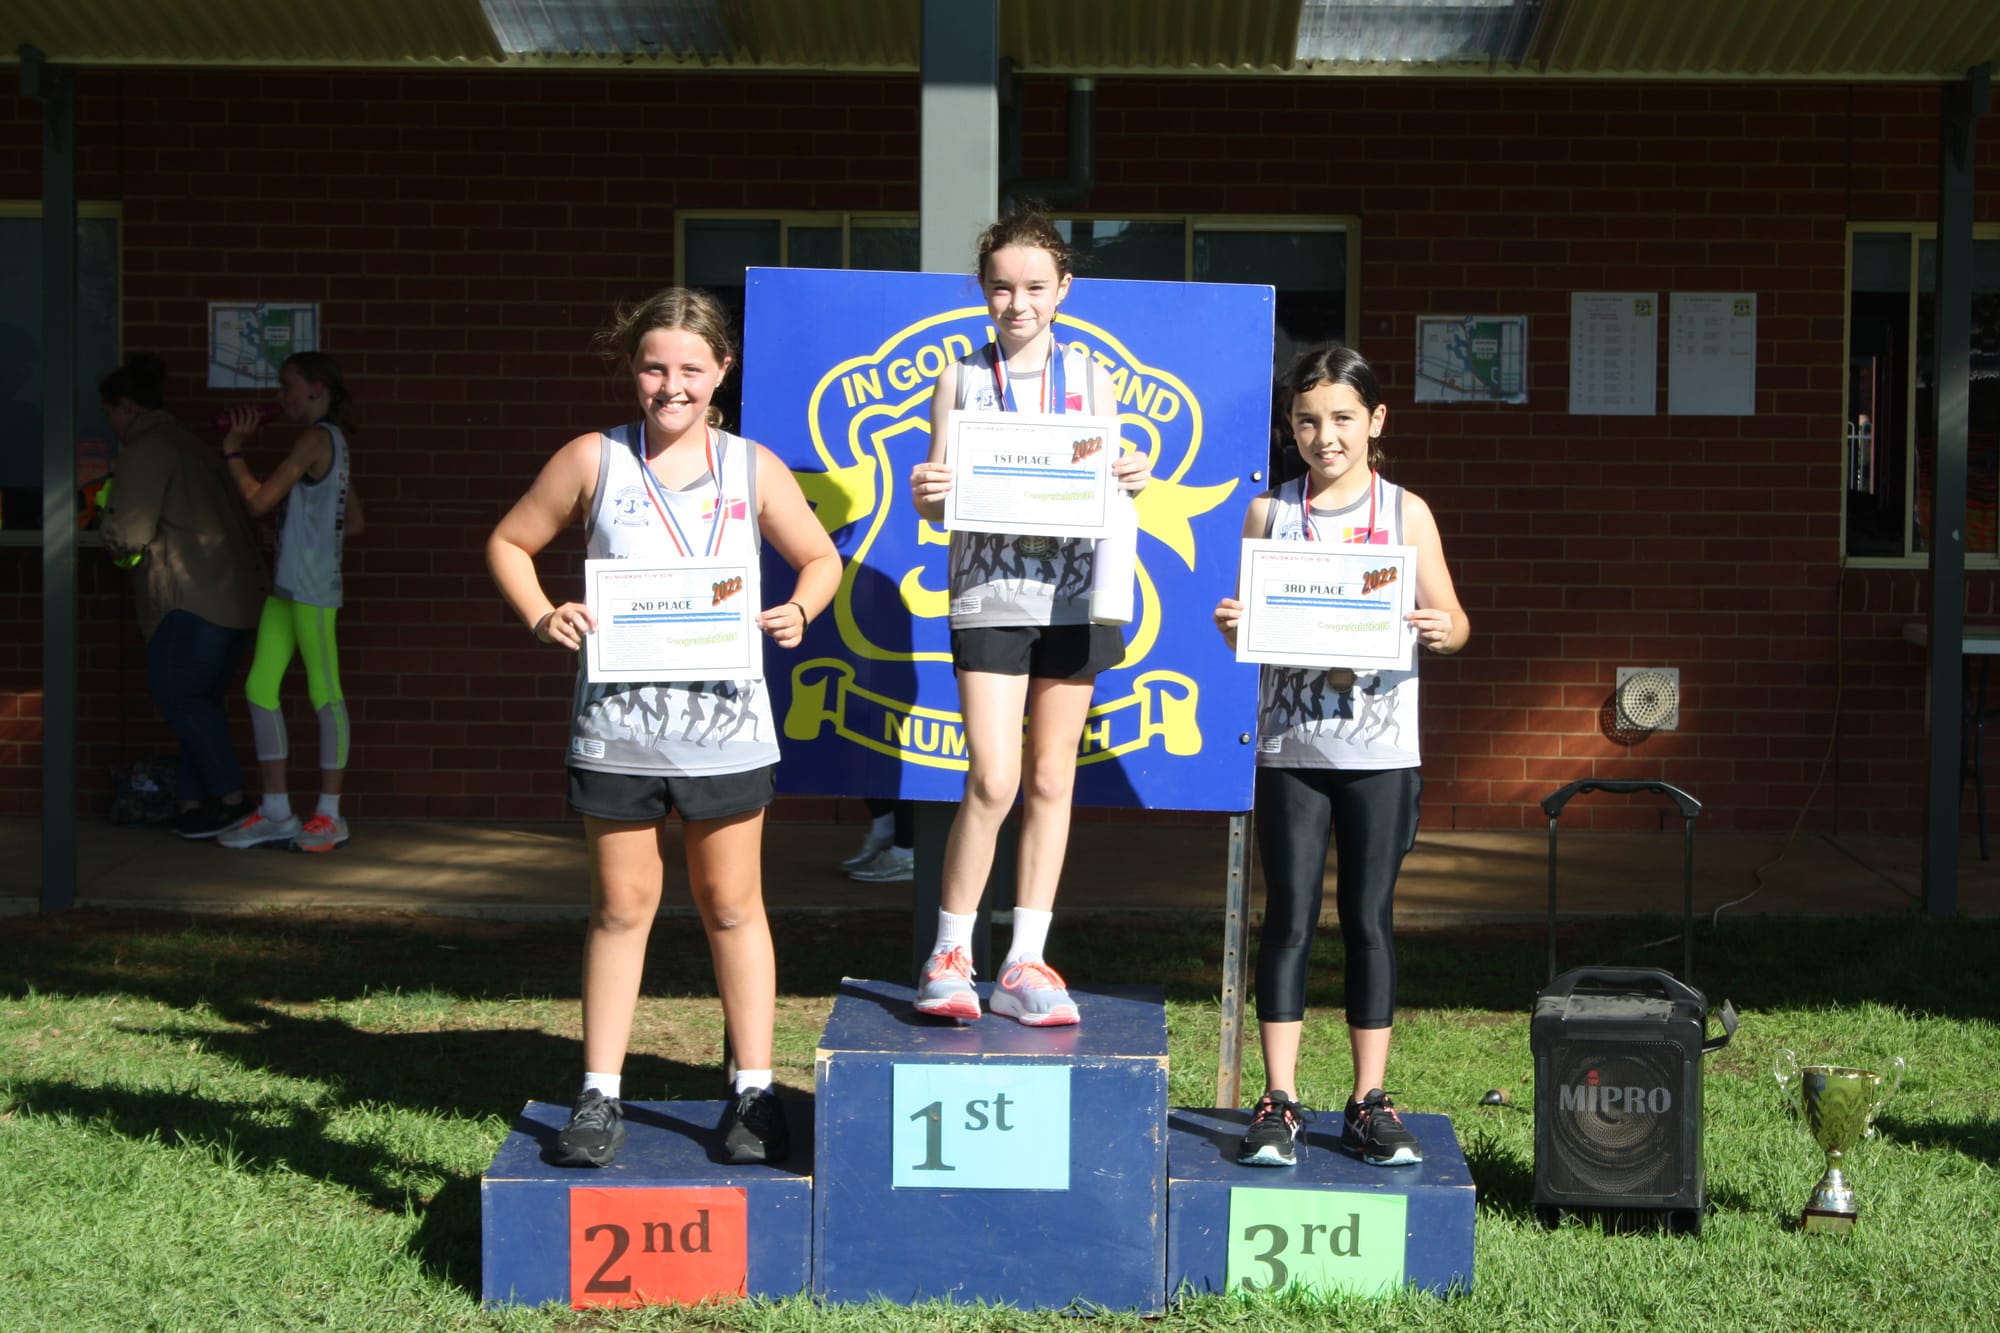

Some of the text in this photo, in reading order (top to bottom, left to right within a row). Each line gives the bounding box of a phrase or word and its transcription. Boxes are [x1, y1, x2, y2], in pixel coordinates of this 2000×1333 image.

[842, 368, 884, 408] IN
[887, 334, 973, 391] GOD
[994, 454, 1051, 466] 1ST PLACE
[1071, 436, 1103, 465] 2022
[711, 575, 743, 606] 2022
[1282, 583, 1345, 596] 3RD PLACE
[1361, 566, 1397, 595] 2022
[631, 600, 693, 611] 2ND PLACE
[910, 1092, 1014, 1171] 1st
[584, 1209, 712, 1294] 2nd
[1241, 1213, 1361, 1295] 3rd
